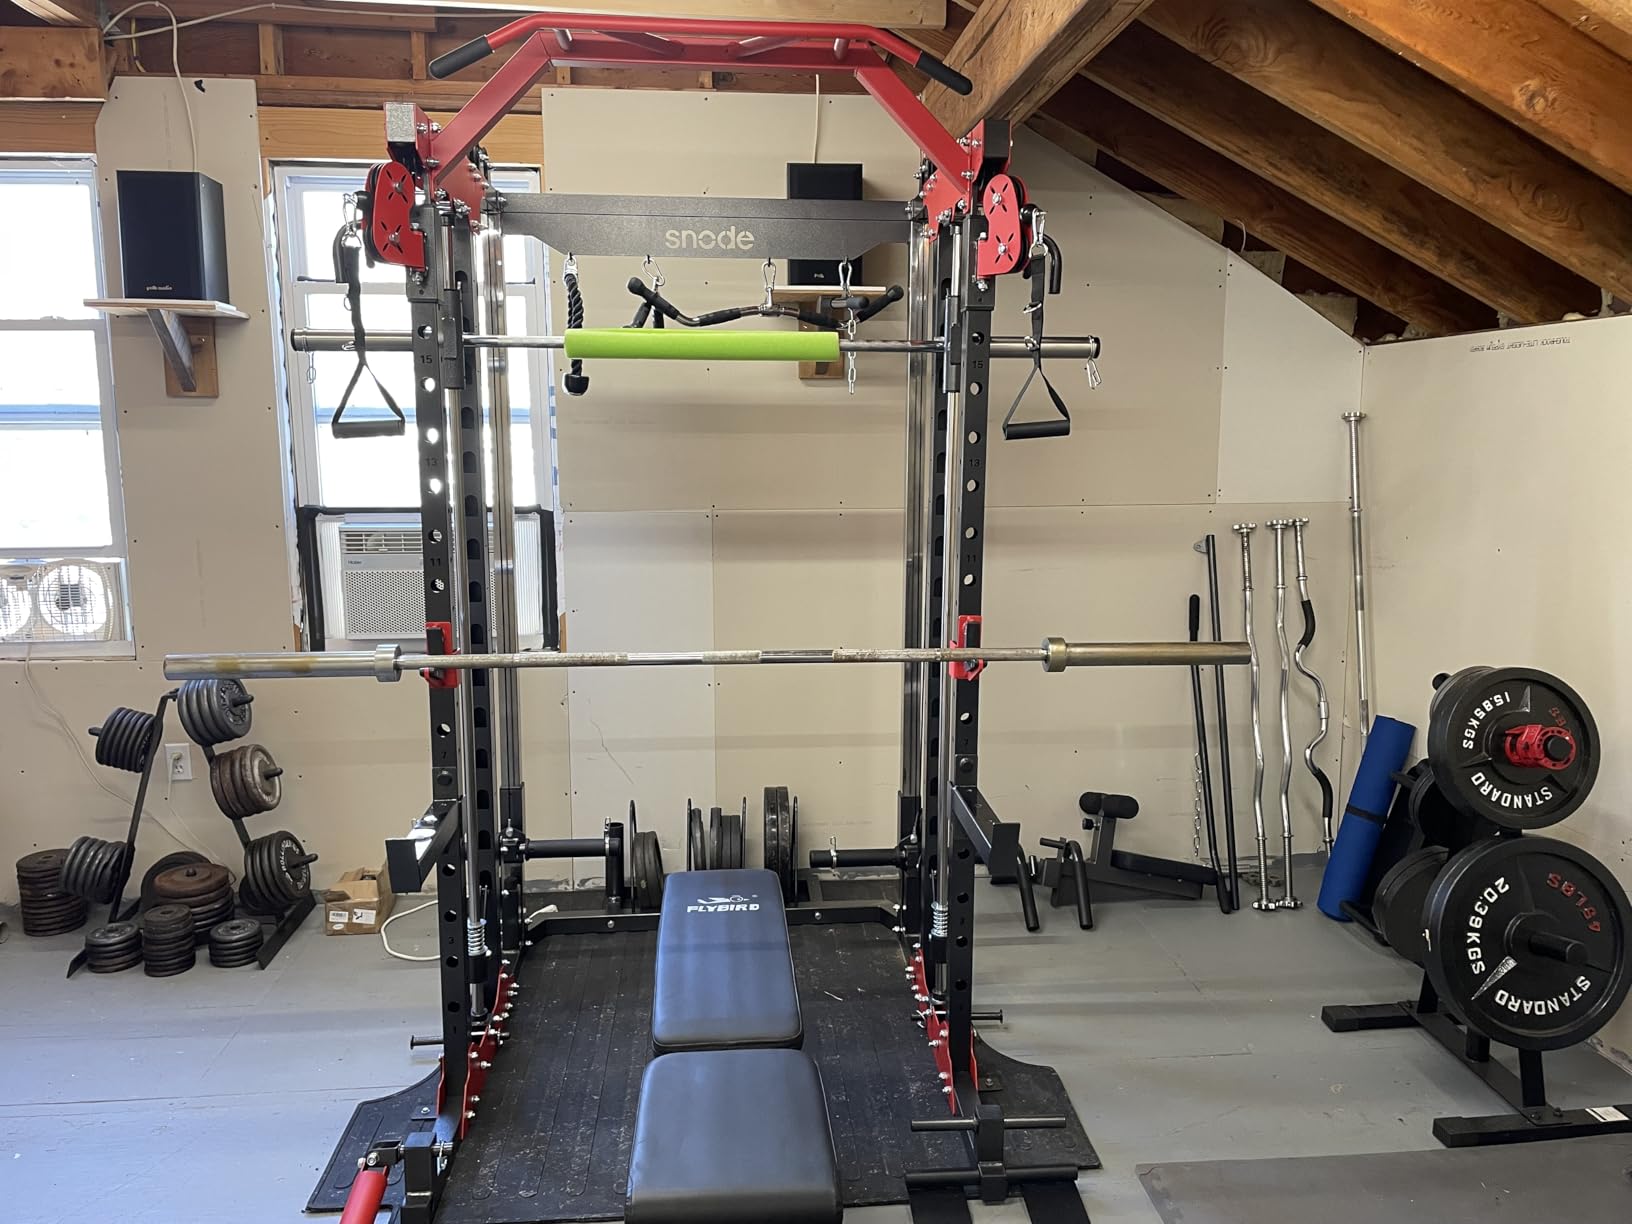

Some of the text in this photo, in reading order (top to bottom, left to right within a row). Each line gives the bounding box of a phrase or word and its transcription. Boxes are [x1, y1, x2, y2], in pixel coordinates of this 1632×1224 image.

[665, 226, 755, 250] snode
[420, 355, 433, 364] 15
[972, 361, 984, 369] 15
[425, 458, 438, 467] 13
[969, 459, 981, 467] 13
[430, 558, 441, 567] 11
[967, 554, 977, 563] 11
[1470, 771, 1553, 809] STANDARD
[687, 903, 760, 913] FLYBIRD
[448, 936, 455, 945] 3
[1494, 975, 1592, 1016] STANDARD
